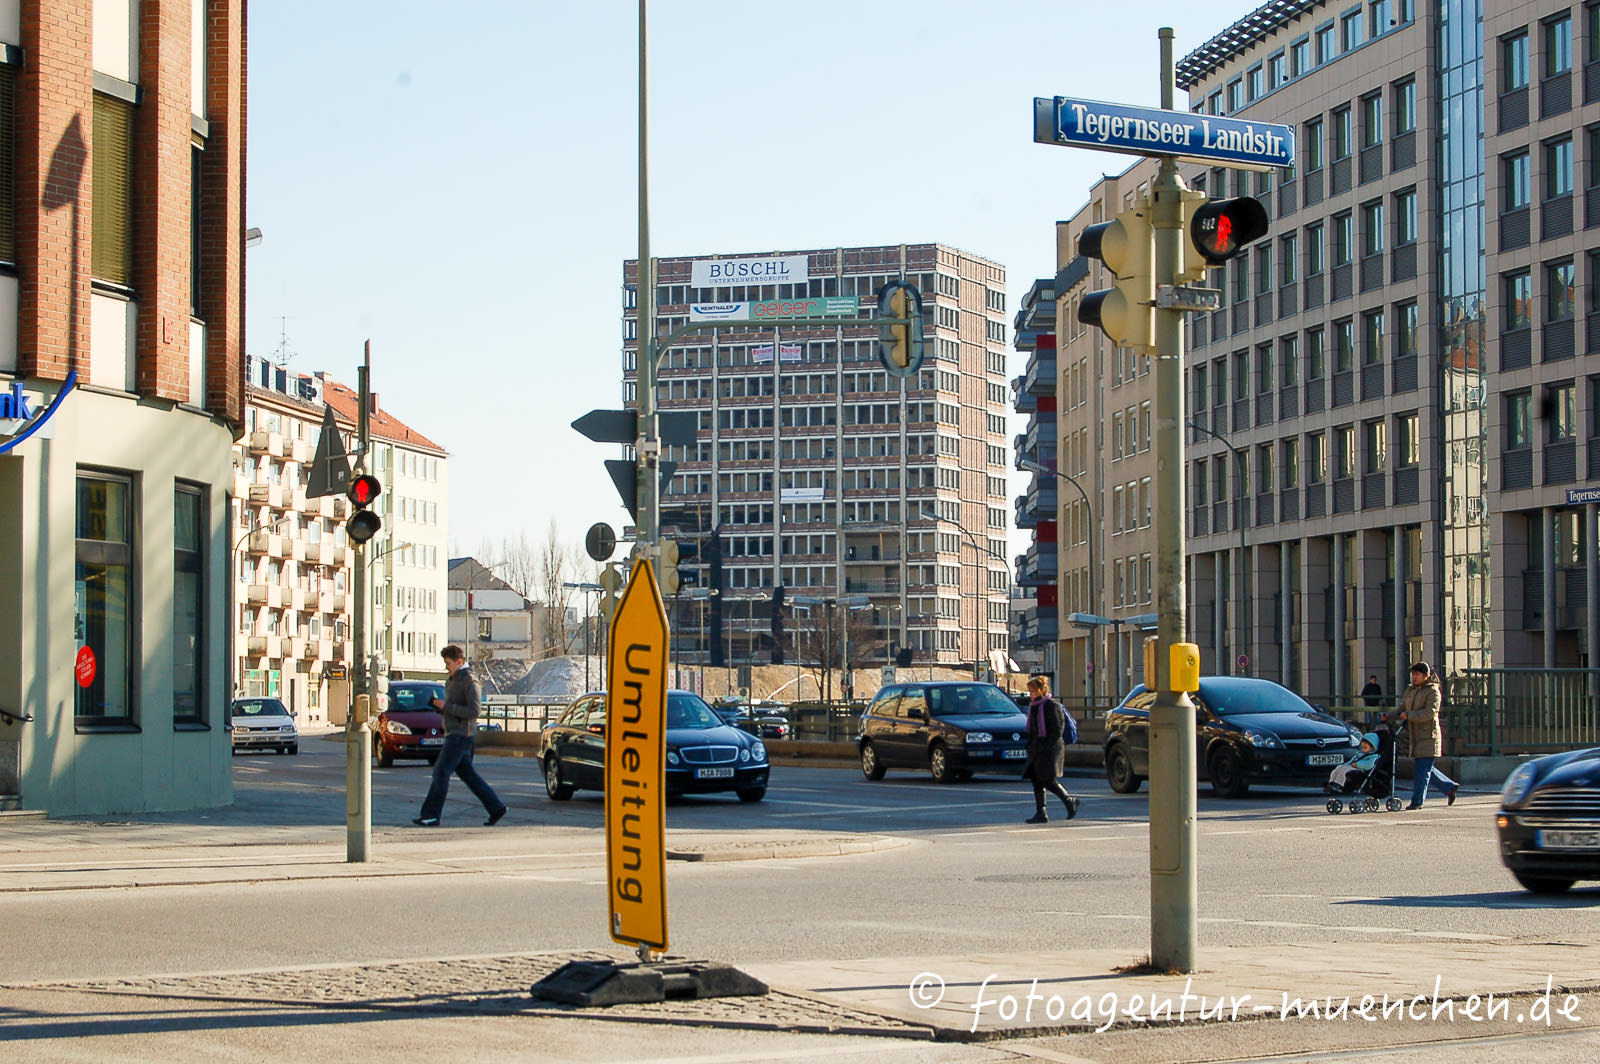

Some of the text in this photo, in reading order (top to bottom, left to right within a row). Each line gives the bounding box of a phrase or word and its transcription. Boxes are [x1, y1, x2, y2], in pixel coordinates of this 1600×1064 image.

[1071, 103, 1286, 158] Tegernseer Landstr.
[709, 275, 790, 284] UNTERNEHMENSGRUPPE
[710, 261, 790, 278] BÜSCHL
[617, 643, 651, 904] Umleitung
